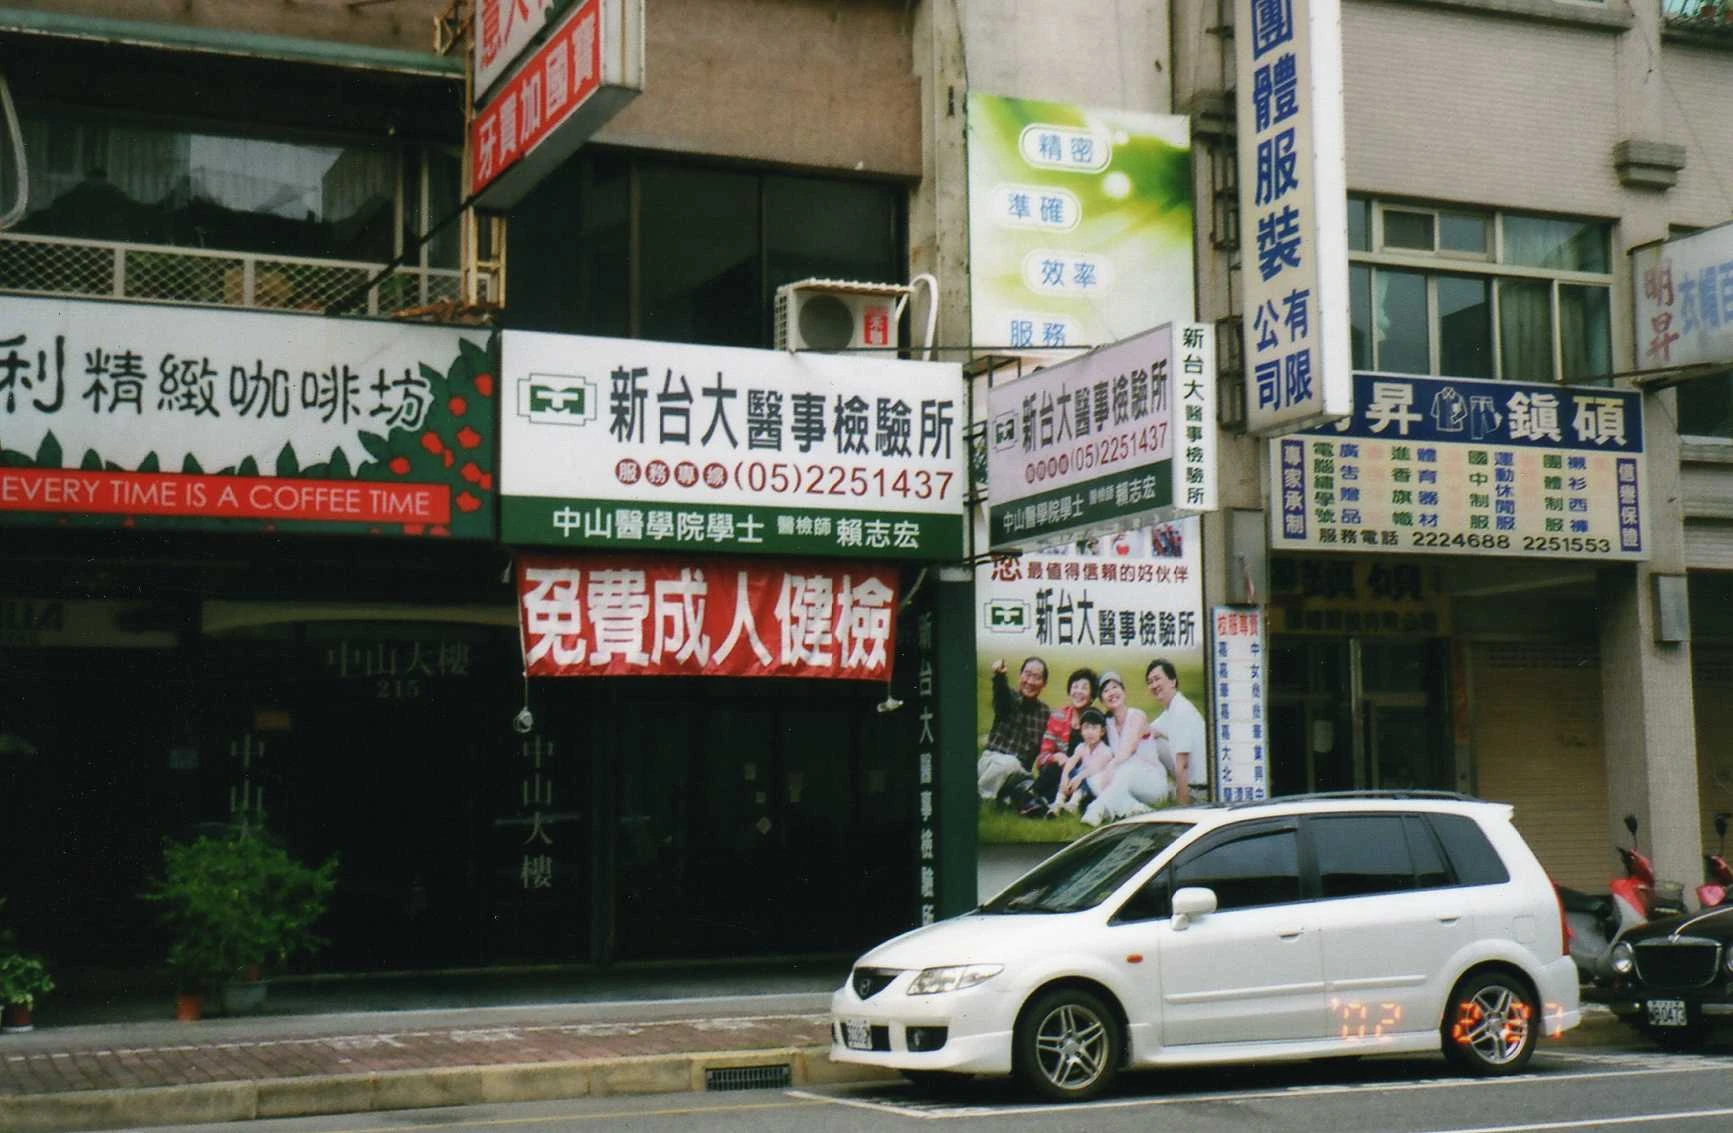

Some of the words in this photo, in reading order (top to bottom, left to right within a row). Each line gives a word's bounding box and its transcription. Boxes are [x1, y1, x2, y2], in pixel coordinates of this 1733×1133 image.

[1038, 133, 1094, 164] 精密
[1251, 0, 1301, 281] 團體服裝
[1008, 193, 1064, 224] 準確
[1041, 259, 1097, 288] 效率
[1010, 319, 1066, 347] 服務
[0, 334, 431, 428] 利精緻咖啡坊
[1022, 358, 1168, 454] 新台大醫事檢驗所
[609, 366, 955, 460] 新台大醫事檢驗所
[1183, 327, 1205, 505] 新台大醫事檢驗所
[1070, 422, 1168, 473] (05)2251437
[2, 476, 100, 503] EVERY
[110, 480, 177, 506] TIME
[186, 482, 207, 508] IS
[217, 484, 239, 509] A
[249, 485, 362, 514] COFFEE
[369, 489, 431, 516] TIME
[734, 461, 953, 500] (05)2251437
[1339, 443, 1362, 525] 廣告贈品
[1390, 445, 1414, 527] 進香旗幟
[1417, 448, 1439, 528] 體育器材
[553, 506, 765, 545] 中山醫學院學士
[776, 515, 832, 537] 醫檢師
[836, 518, 921, 549] 賴志宏
[1319, 529, 1399, 546] 服務電話
[1412, 531, 1511, 550] 2224688
[1523, 534, 1611, 553] 2251553
[524, 567, 895, 671] 免費成人健檢
[1035, 588, 1196, 648] 新台大醫事檢驗所
